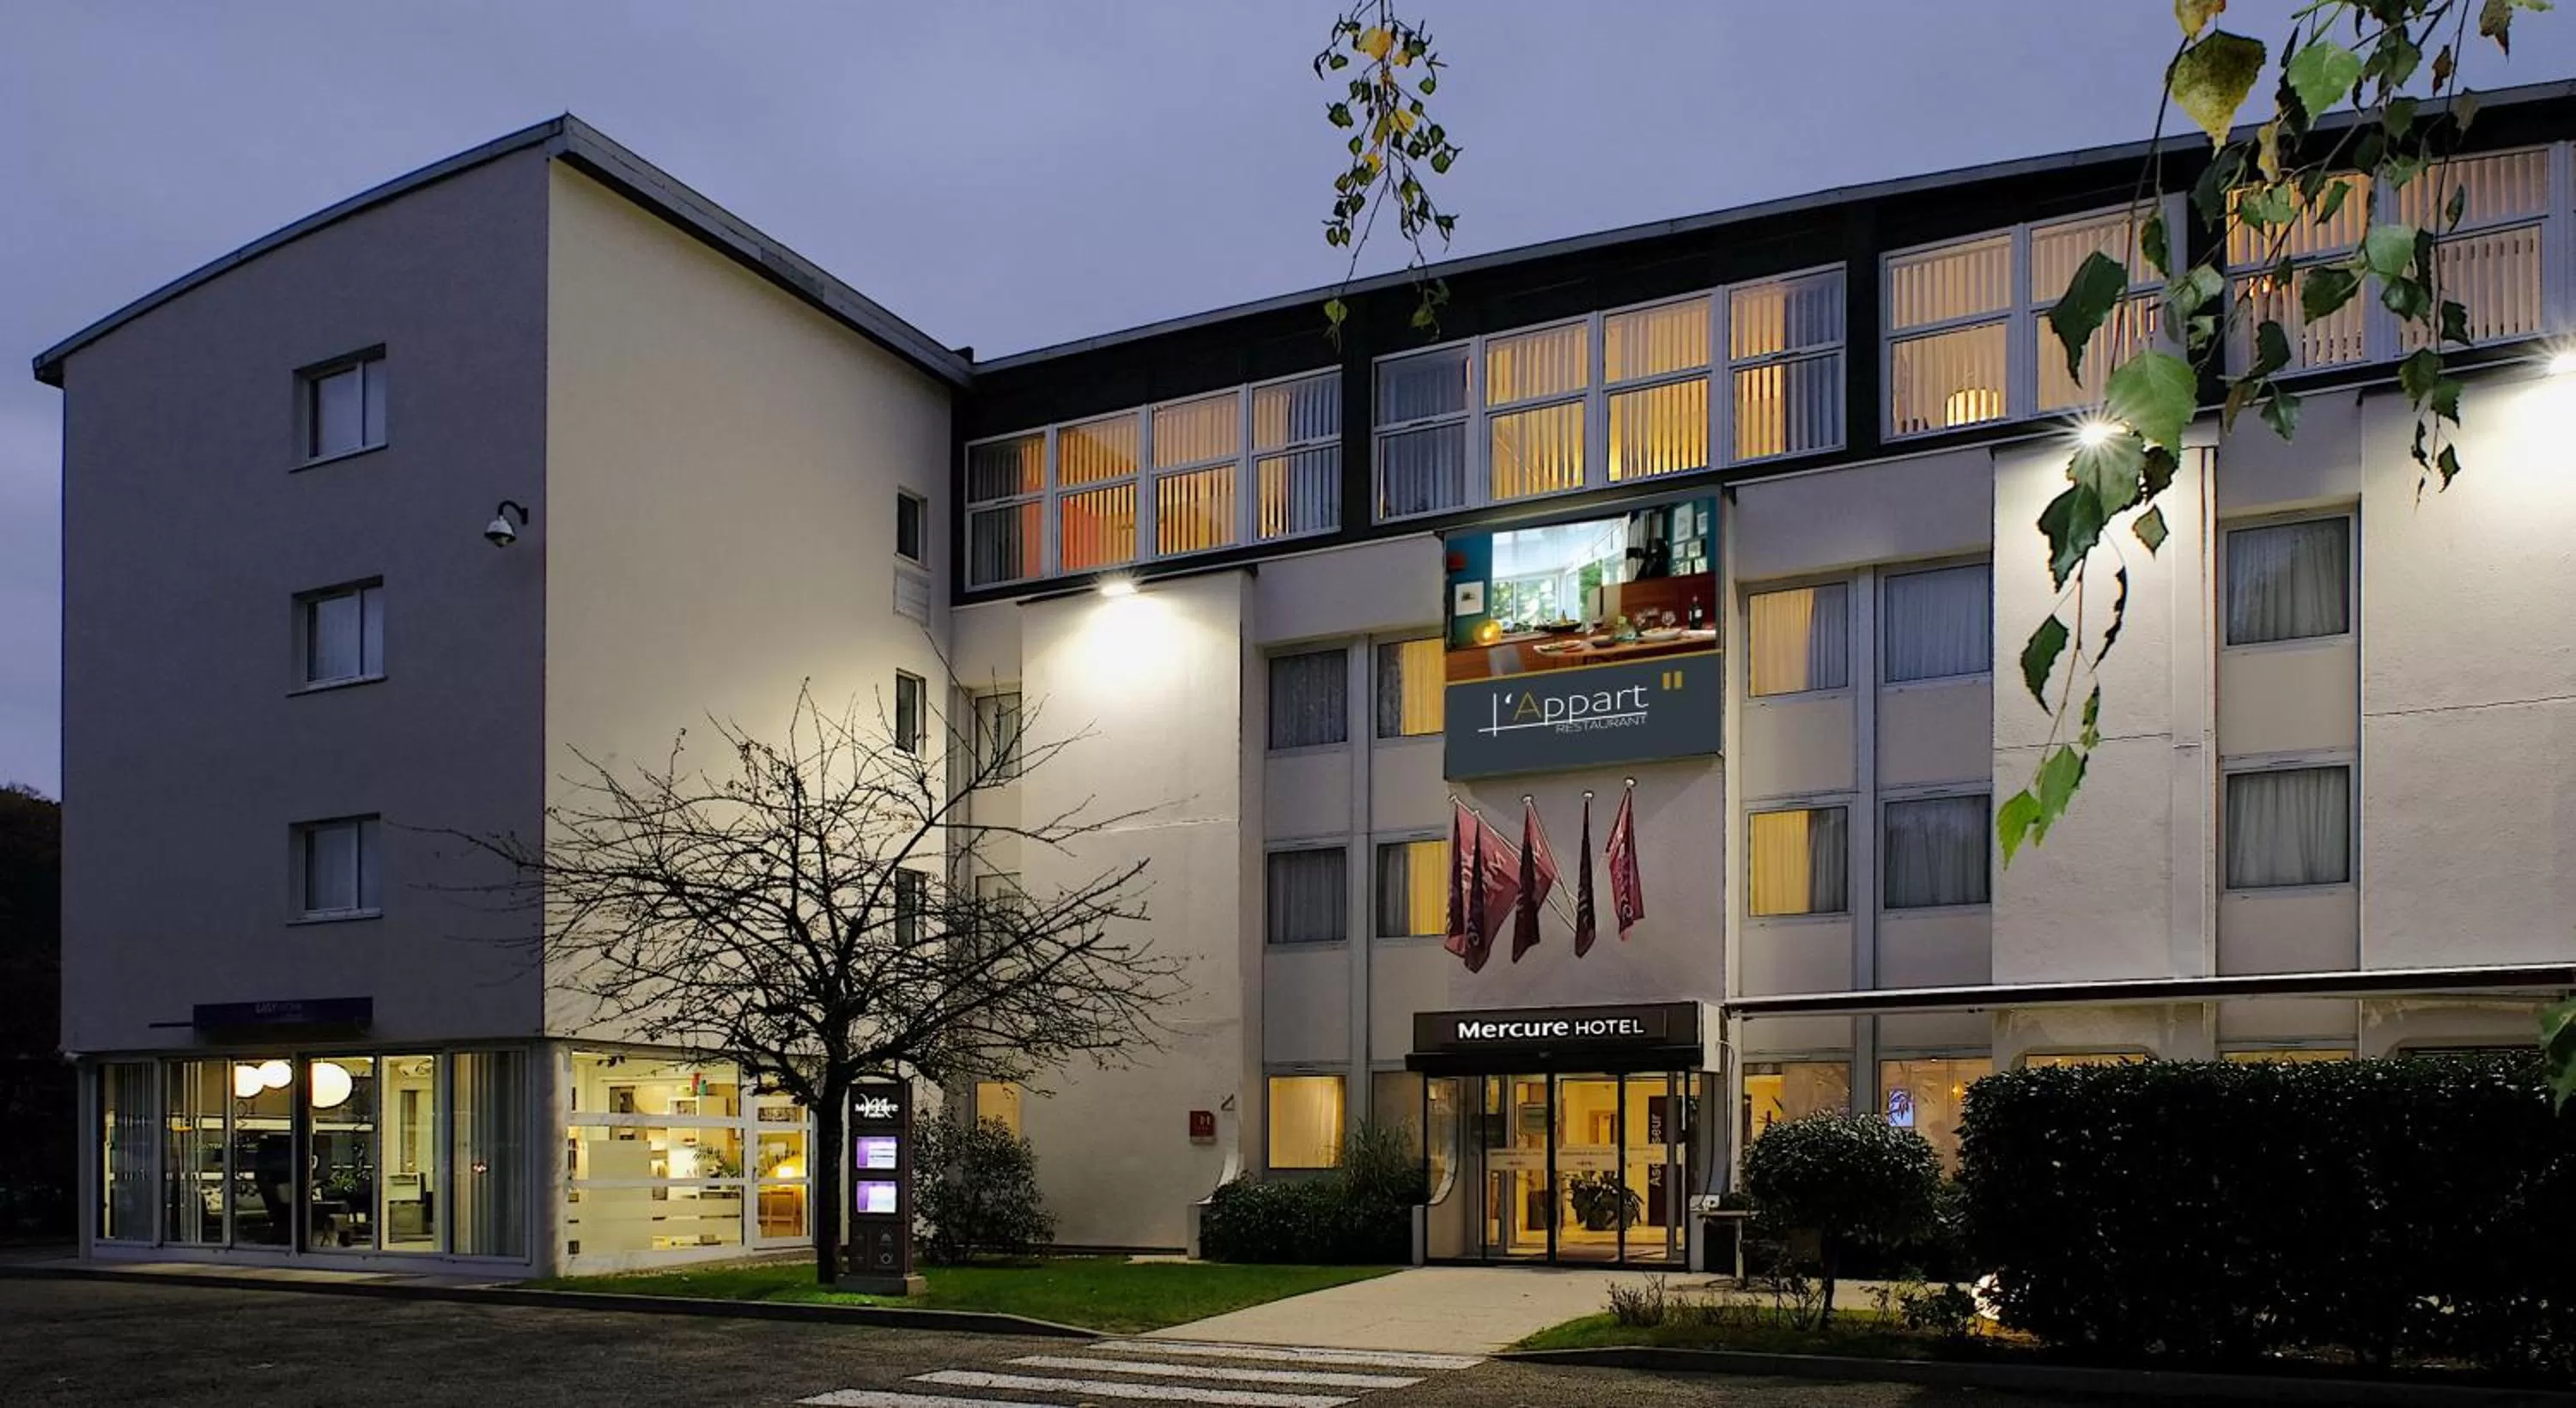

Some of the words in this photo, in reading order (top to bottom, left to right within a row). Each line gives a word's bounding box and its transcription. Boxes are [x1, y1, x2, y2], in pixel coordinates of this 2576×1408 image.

[1554, 715, 1648, 735] RESTAURANT
[1457, 1021, 1569, 1039] Mercure
[1575, 1019, 1644, 1035] HOTEL
[1649, 1113, 1662, 1187] Ascseur
